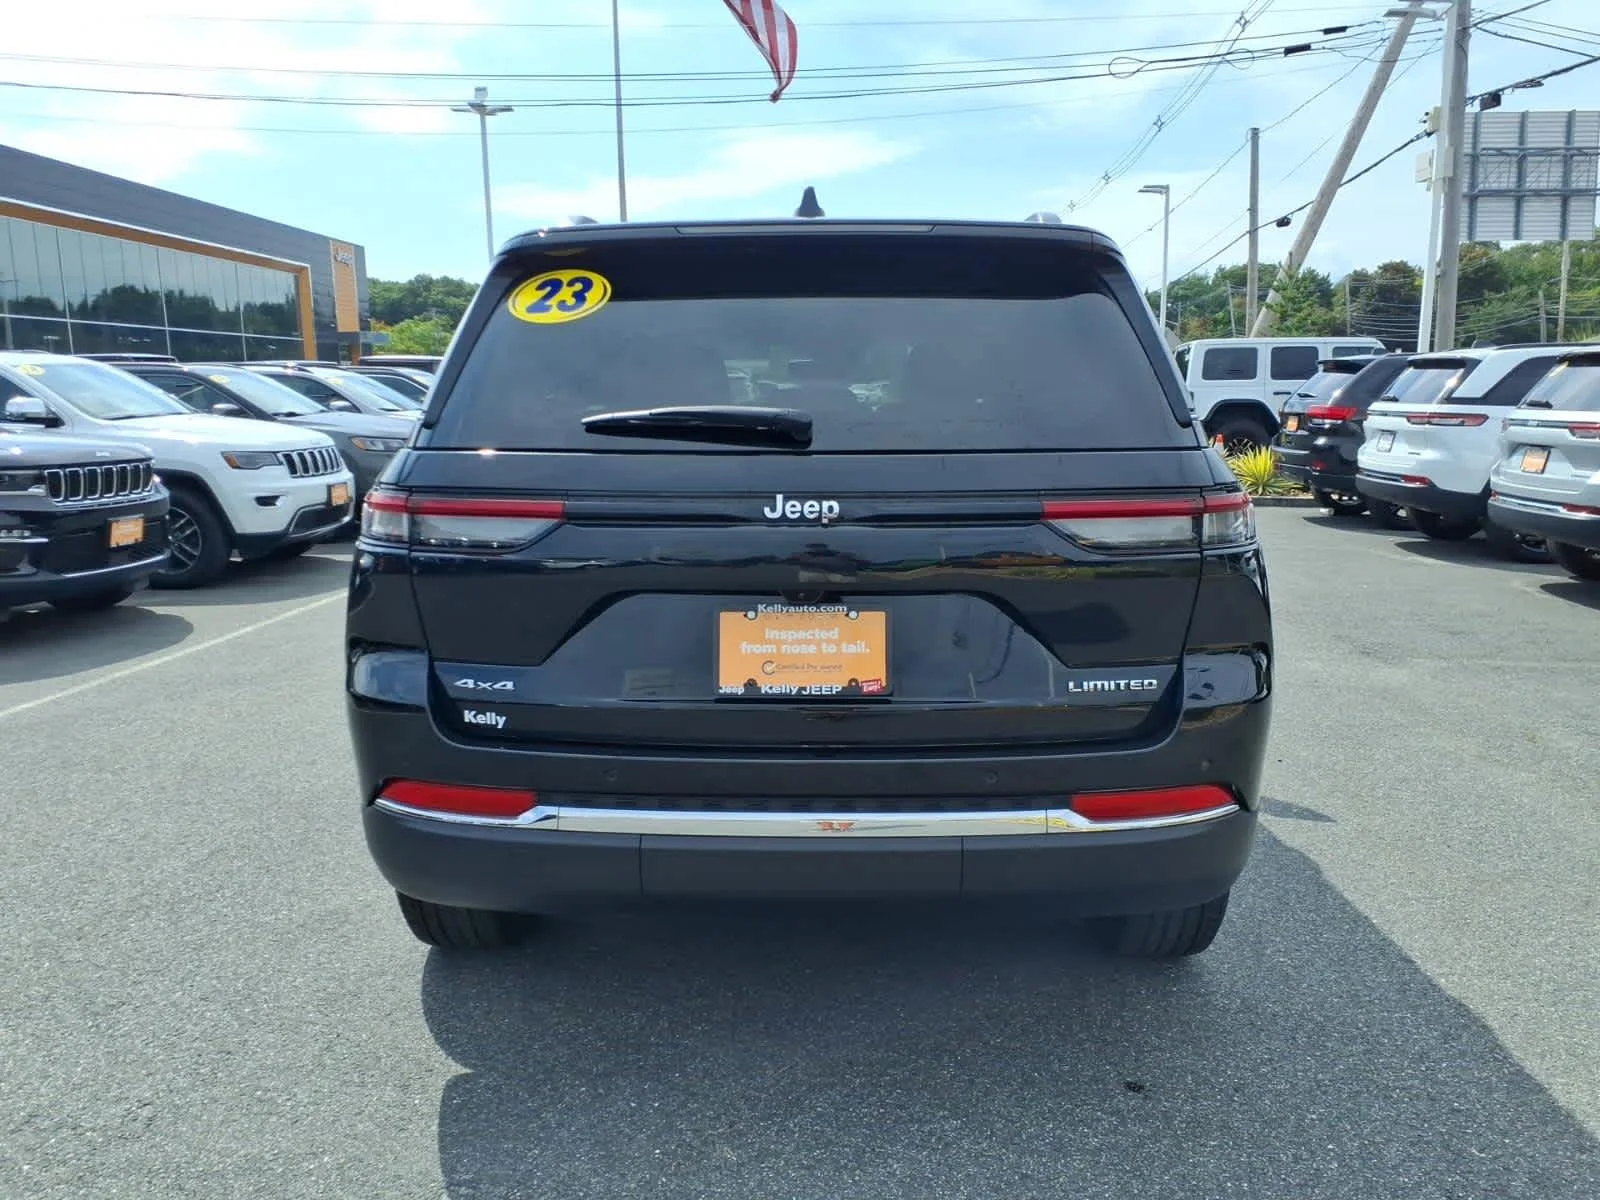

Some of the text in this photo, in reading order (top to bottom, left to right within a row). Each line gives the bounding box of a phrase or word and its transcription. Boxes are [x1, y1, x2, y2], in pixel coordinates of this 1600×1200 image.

[526, 276, 594, 314] 23
[763, 493, 840, 524] Jeep
[757, 604, 848, 614] Kellyauto.com
[765, 628, 840, 642] Inspected
[740, 640, 870, 654] from nose to tail.
[453, 678, 516, 692] 4x4
[718, 685, 745, 695] Jeep
[760, 684, 842, 695] Kelly JEEP
[1067, 679, 1158, 692] LIMITED
[463, 709, 507, 729] Kelly
